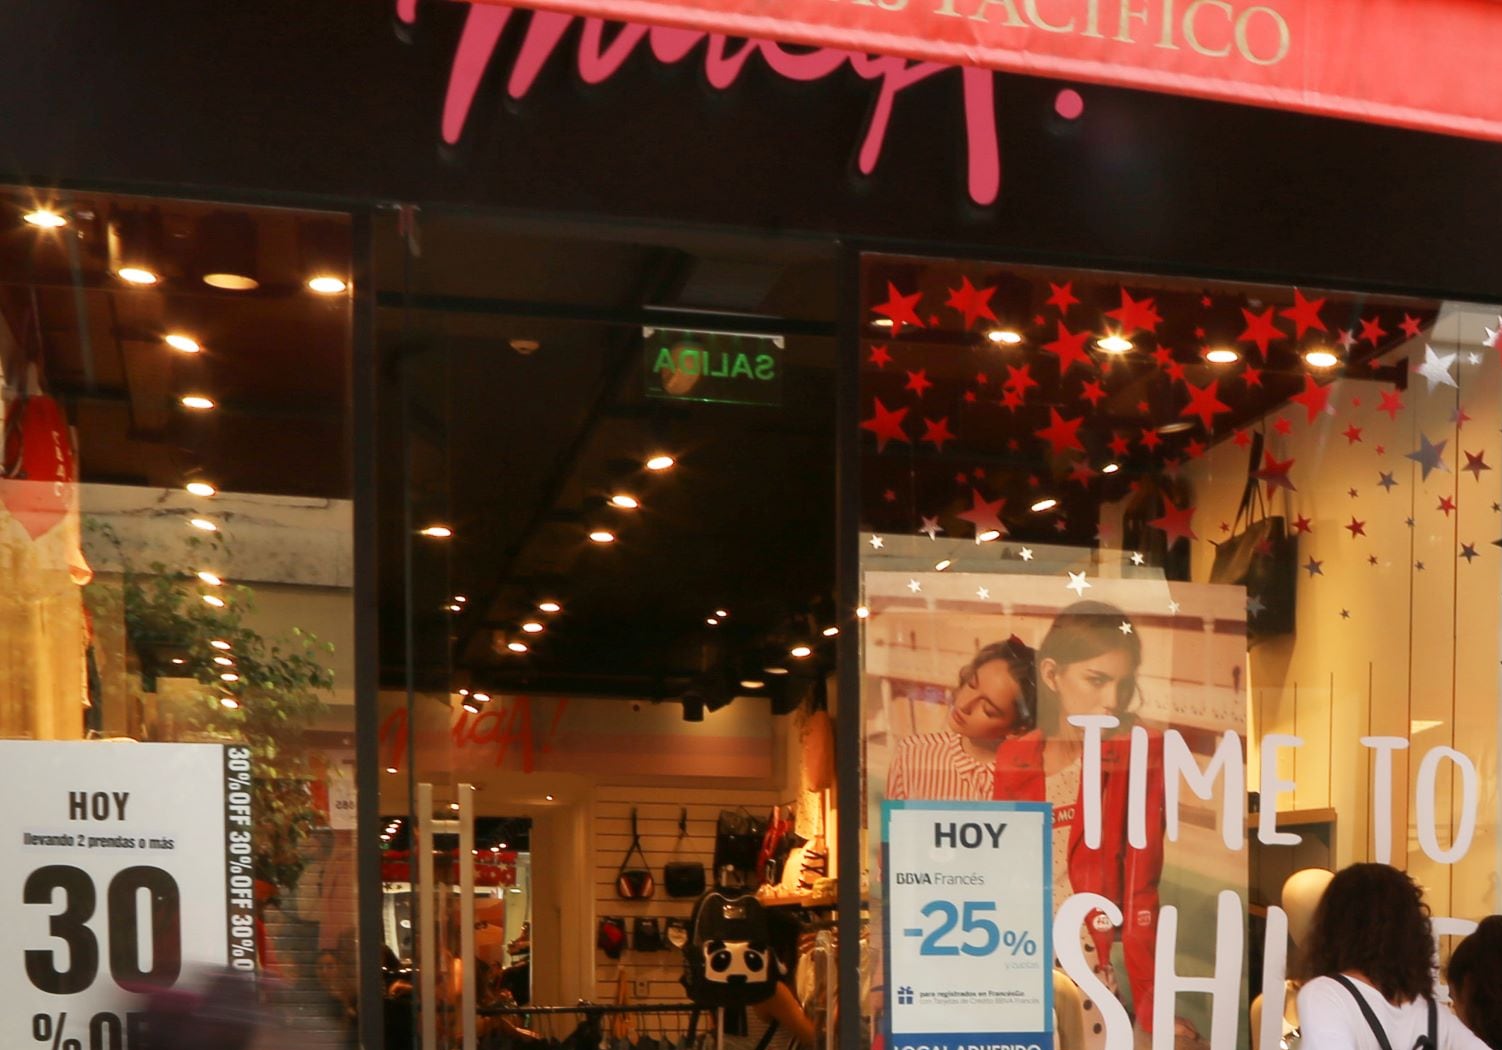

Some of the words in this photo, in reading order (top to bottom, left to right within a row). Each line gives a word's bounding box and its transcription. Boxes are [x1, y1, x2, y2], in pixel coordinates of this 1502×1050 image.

[932, 0, 1291, 66] ACIFICO
[68, 791, 130, 821] HOY
[228, 747, 251, 826] 30%OFF
[1067, 714, 1304, 851] TIME
[1360, 735, 1479, 864] TO
[23, 832, 74, 847] llevando
[77, 834, 85, 847] 2
[87, 835, 136, 849] prendas
[138, 838, 146, 849] o
[149, 836, 175, 850] más
[934, 822, 1007, 848] HOY
[229, 831, 253, 909] 30%OFF
[896, 872, 932, 885] BBVA
[934, 872, 984, 886] Francés
[23, 864, 183, 995] 30
[231, 914, 254, 972] 30%O
